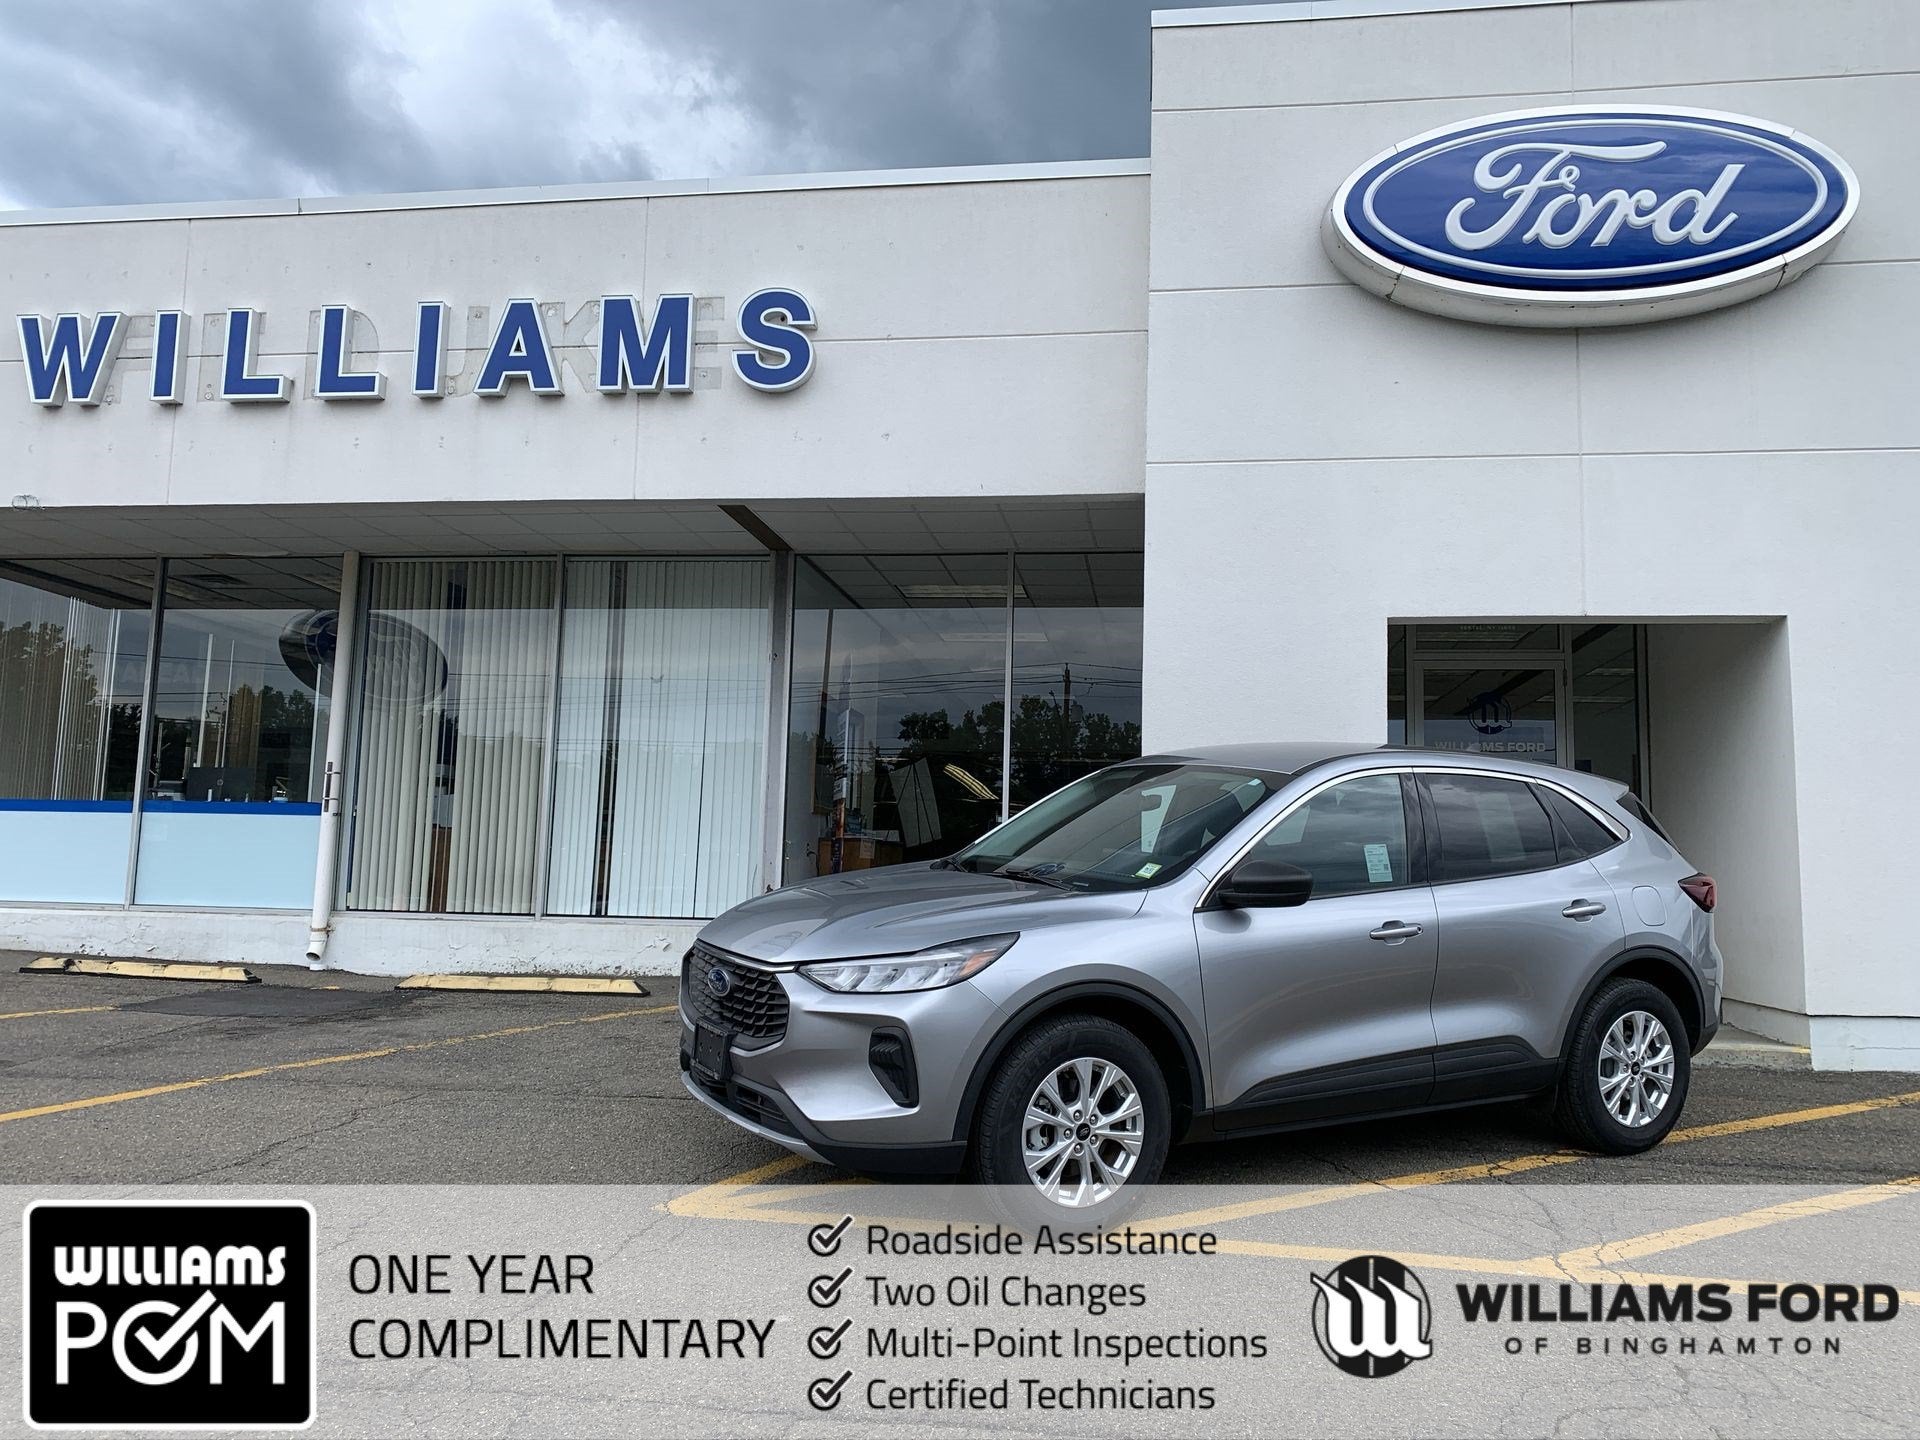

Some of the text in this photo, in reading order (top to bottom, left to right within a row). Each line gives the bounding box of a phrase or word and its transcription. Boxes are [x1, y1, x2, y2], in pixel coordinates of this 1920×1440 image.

[1444, 140, 1745, 250] Ford
[15, 286, 818, 408] WILLIAMS
[1507, 742, 1546, 752] FORD
